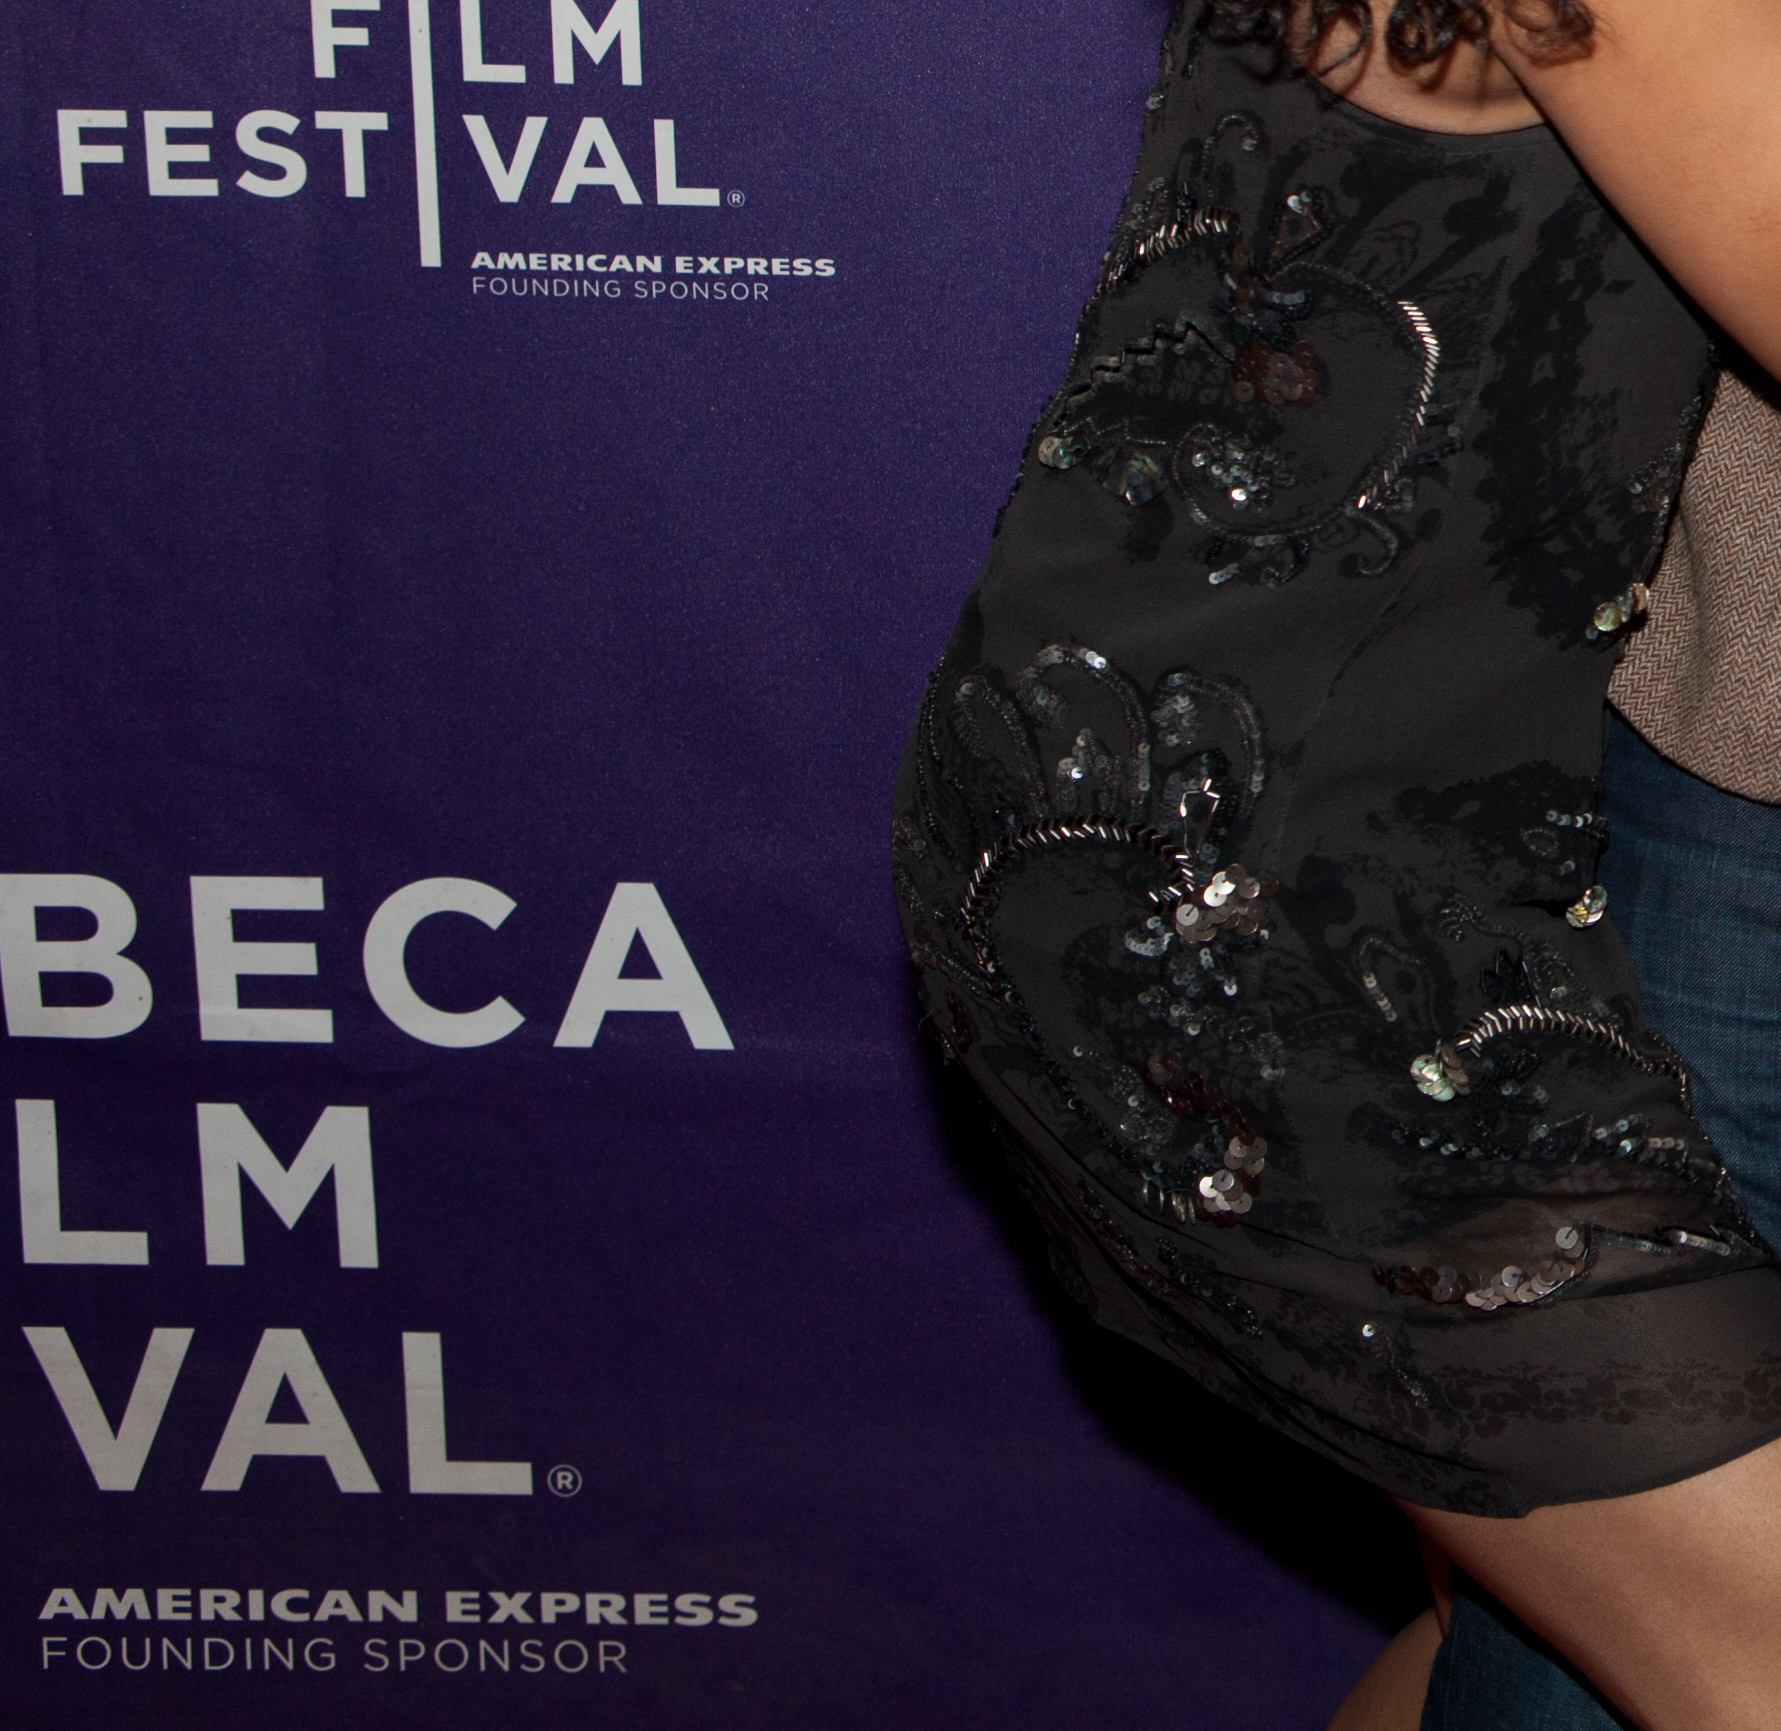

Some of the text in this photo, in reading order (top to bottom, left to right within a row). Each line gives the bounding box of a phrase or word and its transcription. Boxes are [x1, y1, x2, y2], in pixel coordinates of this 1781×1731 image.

[472, 252, 835, 276] AMERICAN EXPRESS
[473, 277, 768, 300] FOUNDING SPONSOR
[40, 1588, 757, 1626] AMERICAN EXPRESS
[43, 1637, 626, 1672] FOUNDING SPONSOR
